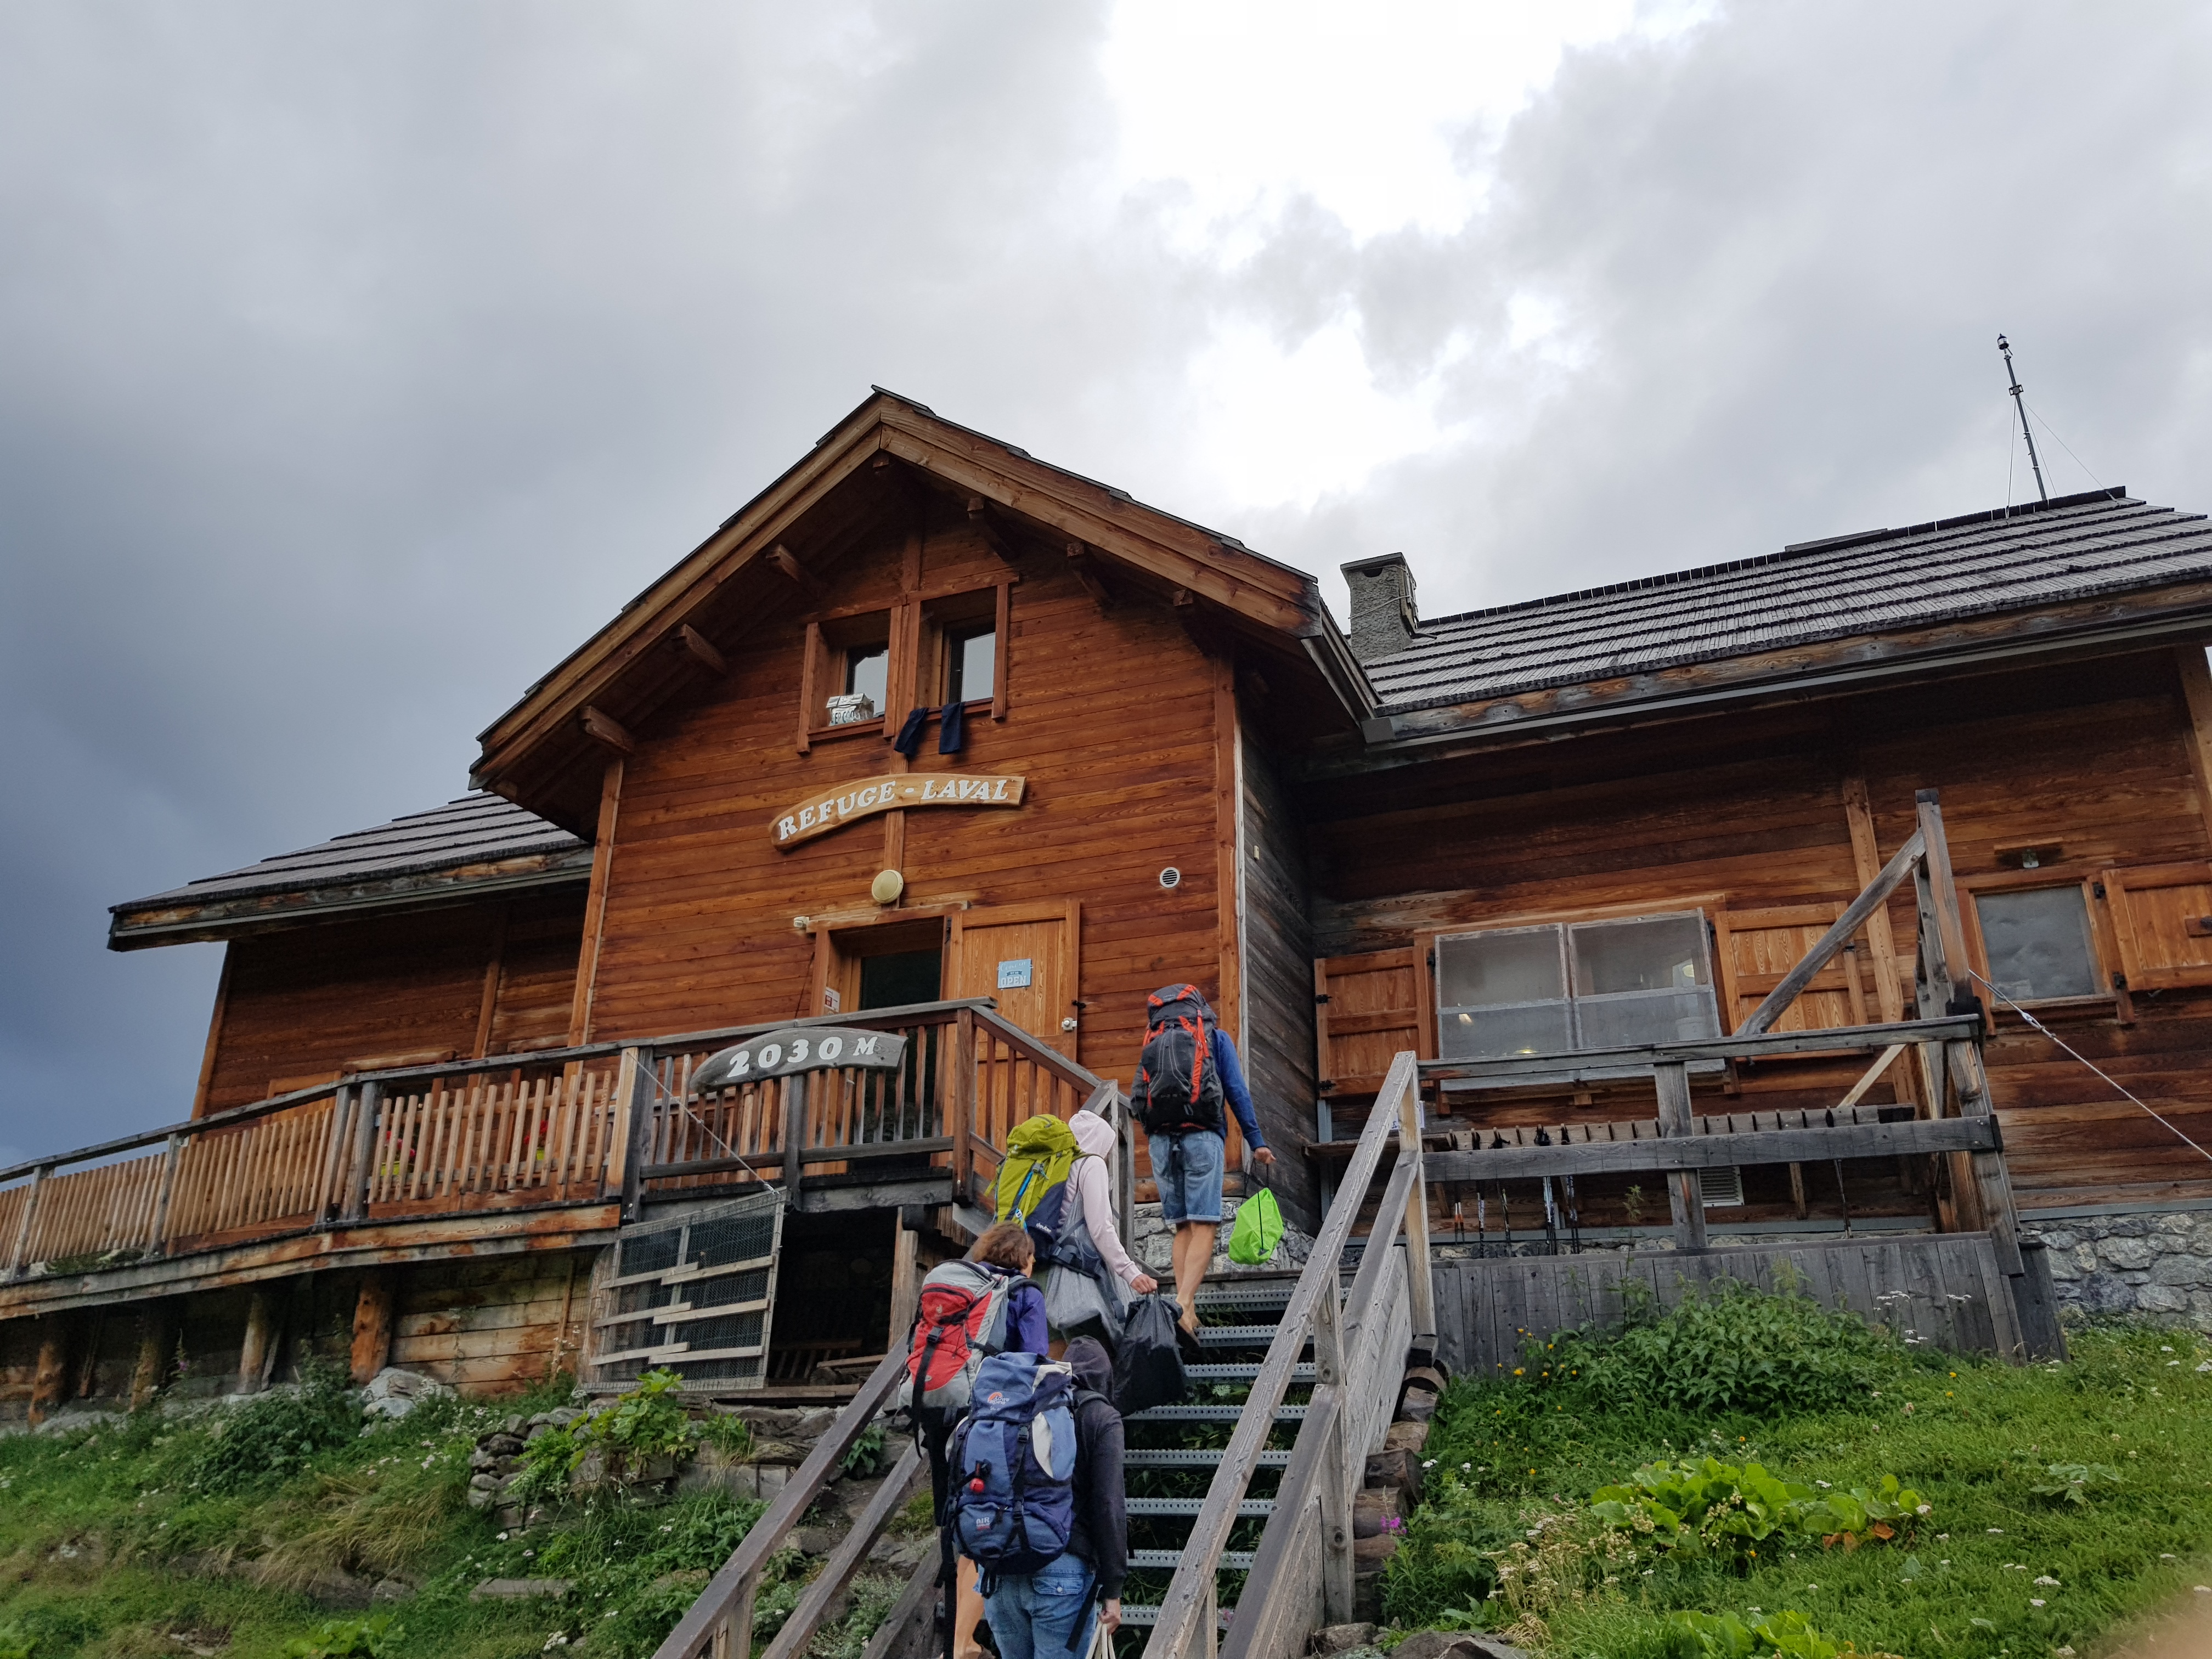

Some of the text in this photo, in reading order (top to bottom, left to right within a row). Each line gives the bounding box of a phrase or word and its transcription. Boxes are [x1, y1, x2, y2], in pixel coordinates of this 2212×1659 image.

[778, 780, 896, 840] REFUGE
[921, 779, 1009, 800] LAVAL
[1001, 975, 1026, 986] OPEN
[726, 1036, 878, 1078] 2030 M
[1036, 1222, 1052, 1233] deuter
